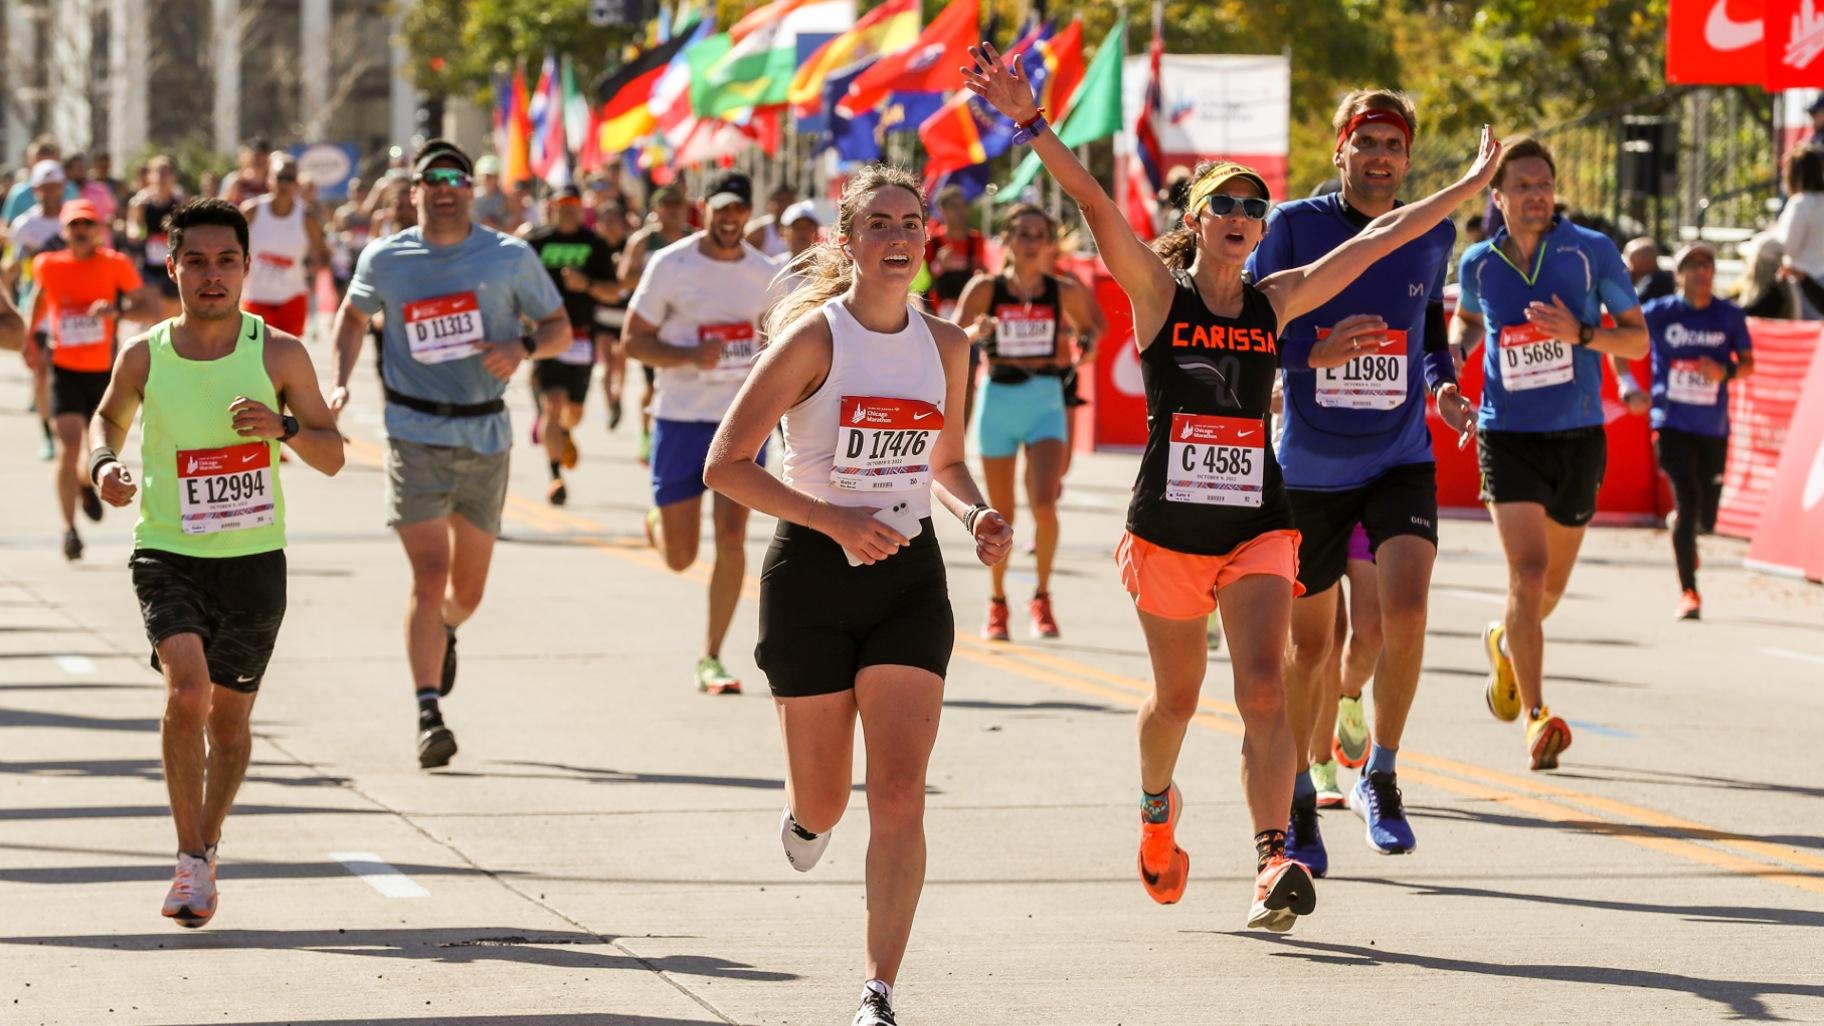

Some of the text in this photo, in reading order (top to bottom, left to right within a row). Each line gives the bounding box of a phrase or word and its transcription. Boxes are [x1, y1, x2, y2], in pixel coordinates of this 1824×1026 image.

[416, 313, 474, 341] D 11313
[1172, 322, 1277, 355] CARISSA
[1507, 339, 1564, 368] D 5686
[1343, 356, 1399, 382] 11980
[867, 410, 888, 419] Chicago
[846, 429, 929, 459] D 17476
[1182, 444, 1252, 475] C 4585
[186, 470, 265, 505] E 12994
